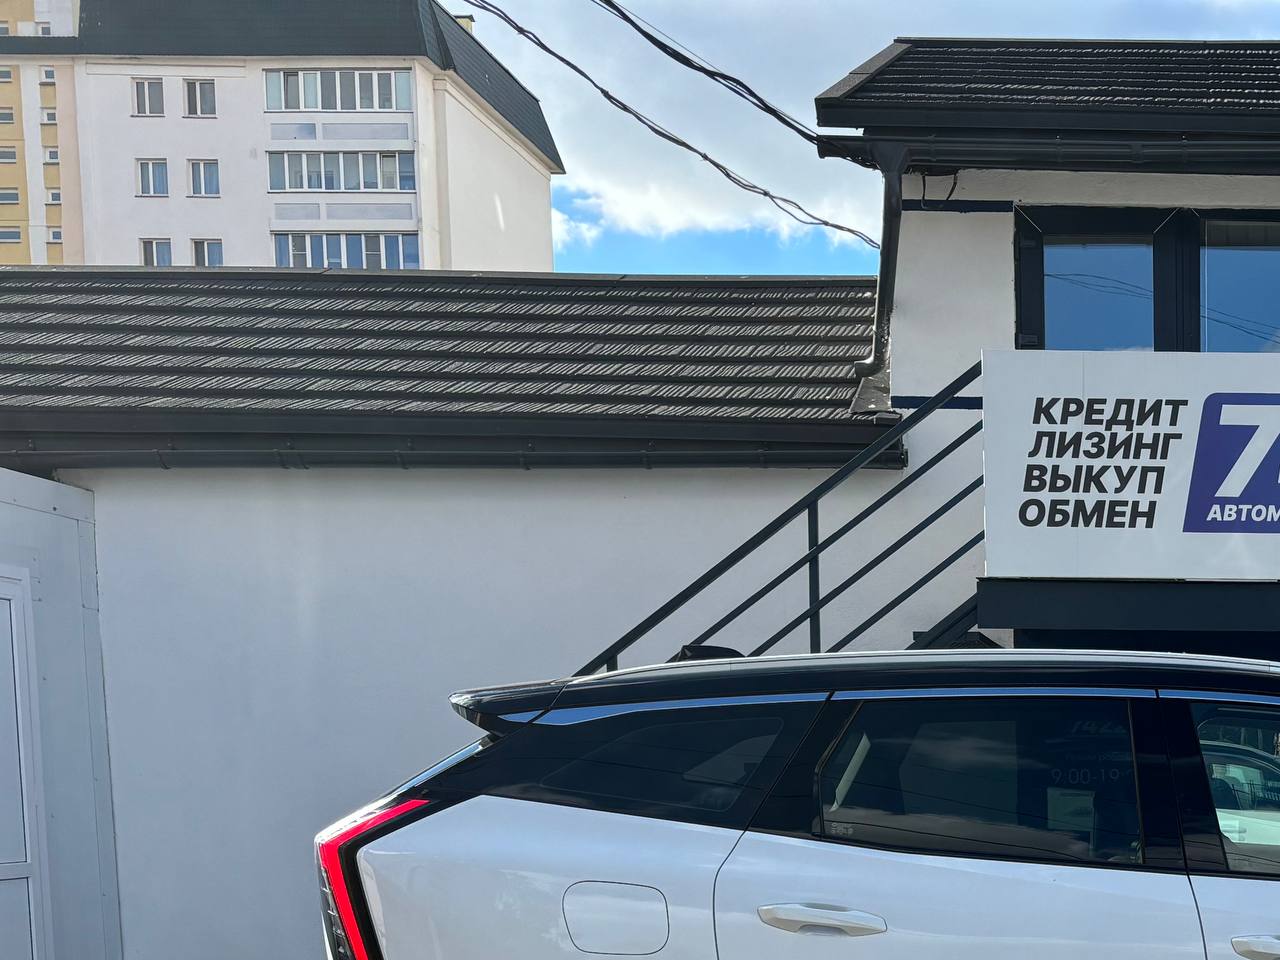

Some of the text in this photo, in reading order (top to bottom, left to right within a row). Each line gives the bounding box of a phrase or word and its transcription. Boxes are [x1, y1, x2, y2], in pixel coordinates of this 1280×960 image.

[1032, 397, 1189, 430] КРЕДИТ
[1027, 431, 1183, 460] ЛИЗИНГ
[1022, 464, 1165, 494] ВЫКУП
[1018, 498, 1157, 529] ОБМЕН
